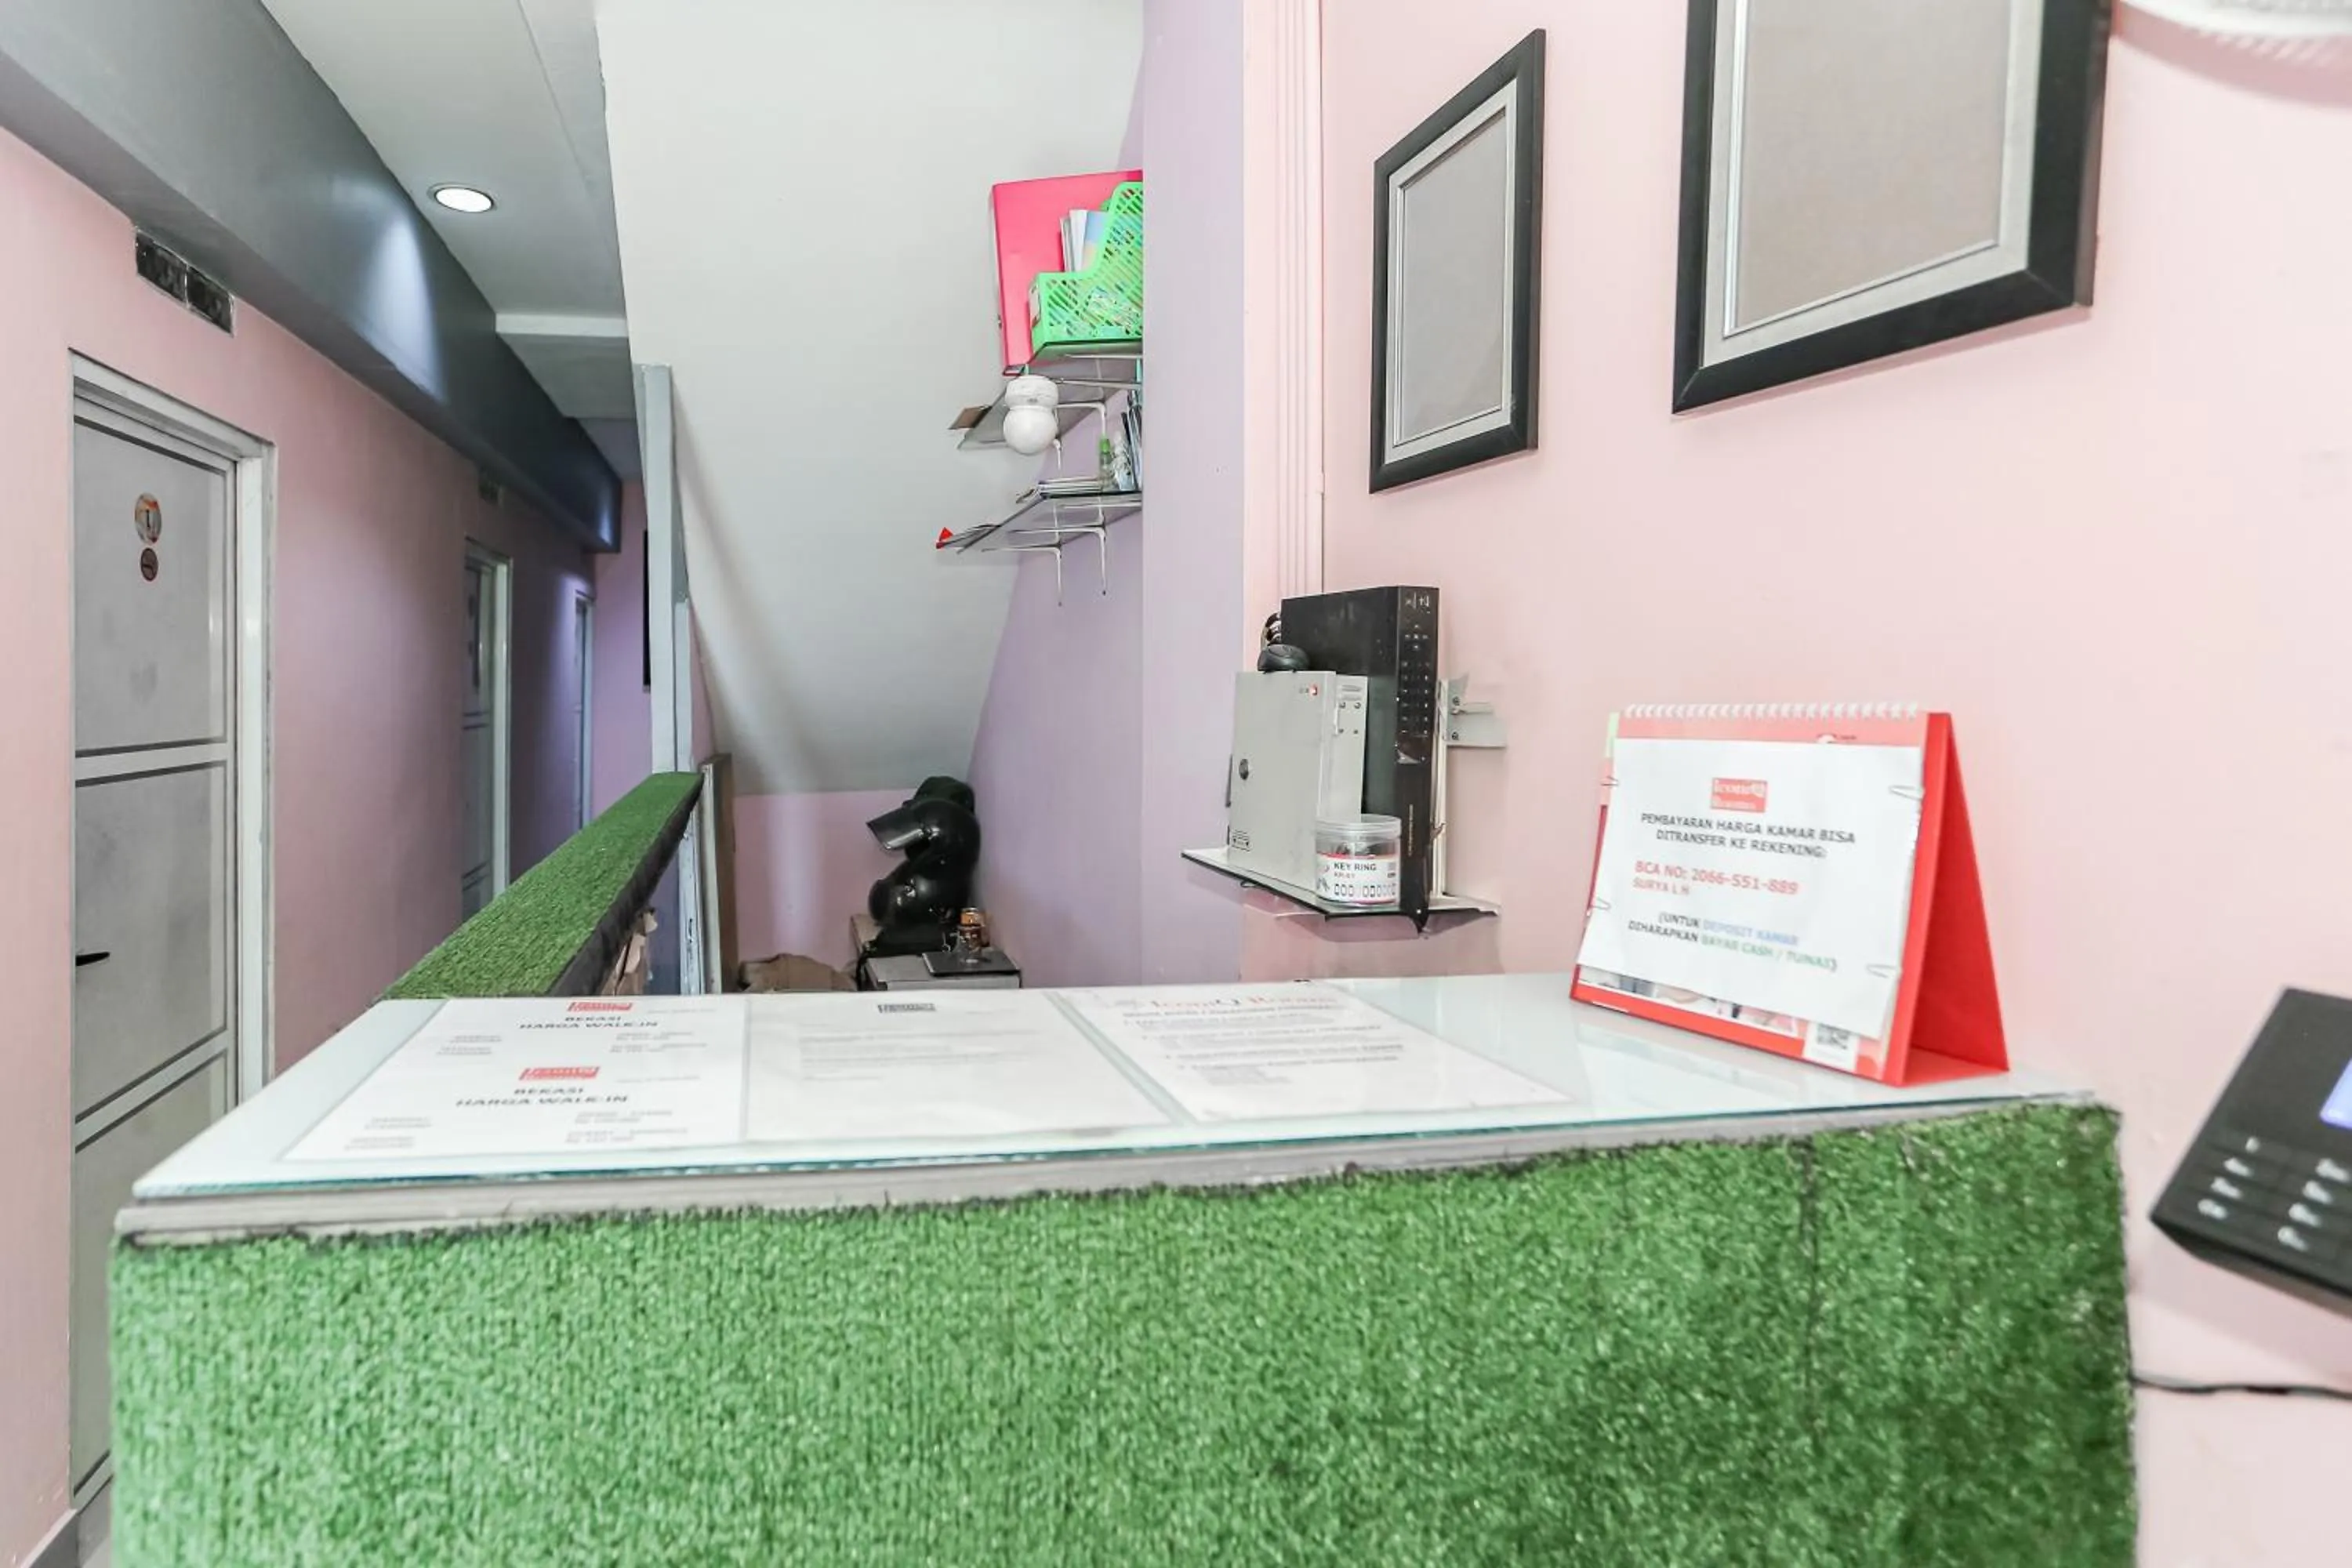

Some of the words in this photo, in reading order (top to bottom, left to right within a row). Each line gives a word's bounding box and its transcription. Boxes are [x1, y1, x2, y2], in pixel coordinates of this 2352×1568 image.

[1640, 812, 1713, 830] PEMBAYARAN
[1716, 819, 1762, 835] HARGA
[1766, 825, 1815, 840] KAMAR
[1819, 829, 1856, 844] BISA
[1656, 829, 1726, 848] DITRANSFER
[1730, 837, 1747, 849] KE
[1334, 862, 1352, 870] KEY
[1632, 877, 1669, 893] SURYA
[1635, 860, 1661, 875] BCA
[1664, 866, 1687, 880] NO:
[1691, 868, 1799, 895] 2066-551-889
[1658, 911, 1700, 928] (UNTUK
[1628, 920, 1699, 943] DIHARAPKAN
